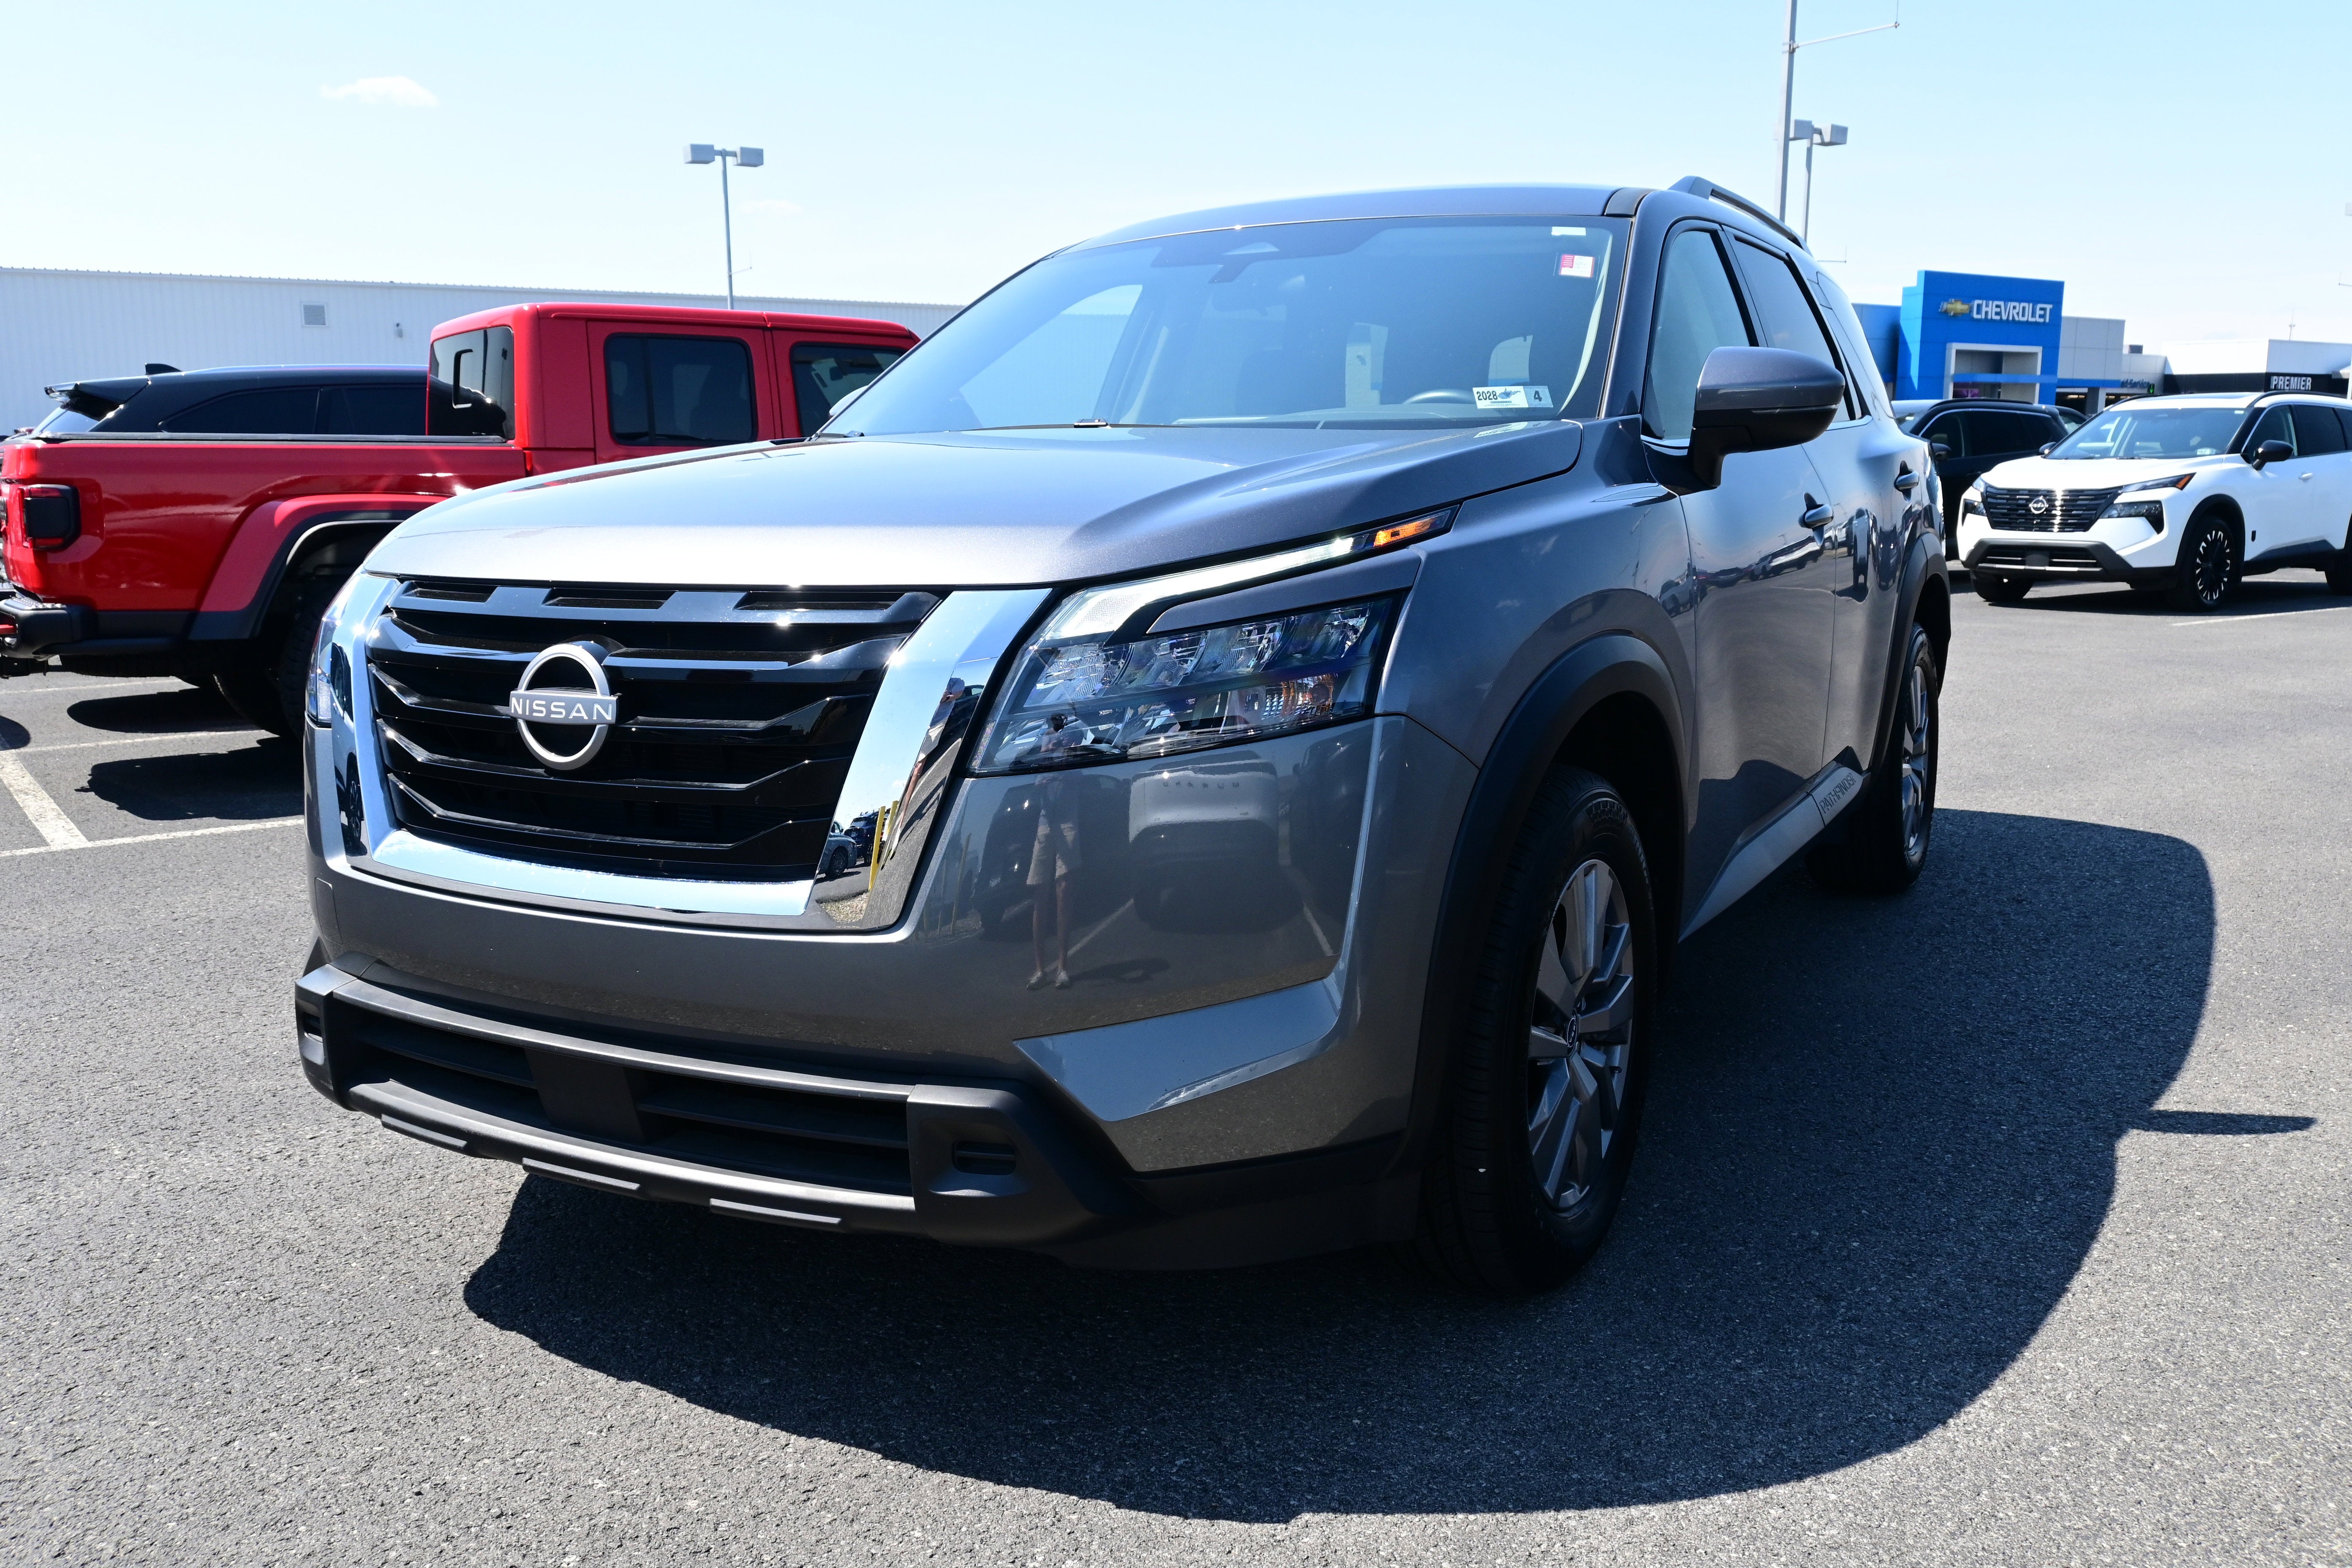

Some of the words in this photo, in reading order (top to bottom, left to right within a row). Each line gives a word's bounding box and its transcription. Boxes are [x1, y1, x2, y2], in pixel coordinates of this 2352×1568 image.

[1973, 299, 2053, 323] CHEVROLET
[2271, 376, 2312, 390] PREMIER
[1476, 390, 1498, 401] 2028
[1533, 390, 1543, 402] 4
[511, 697, 612, 720] NISSAN
[1818, 772, 1856, 814] PATHFINDER
